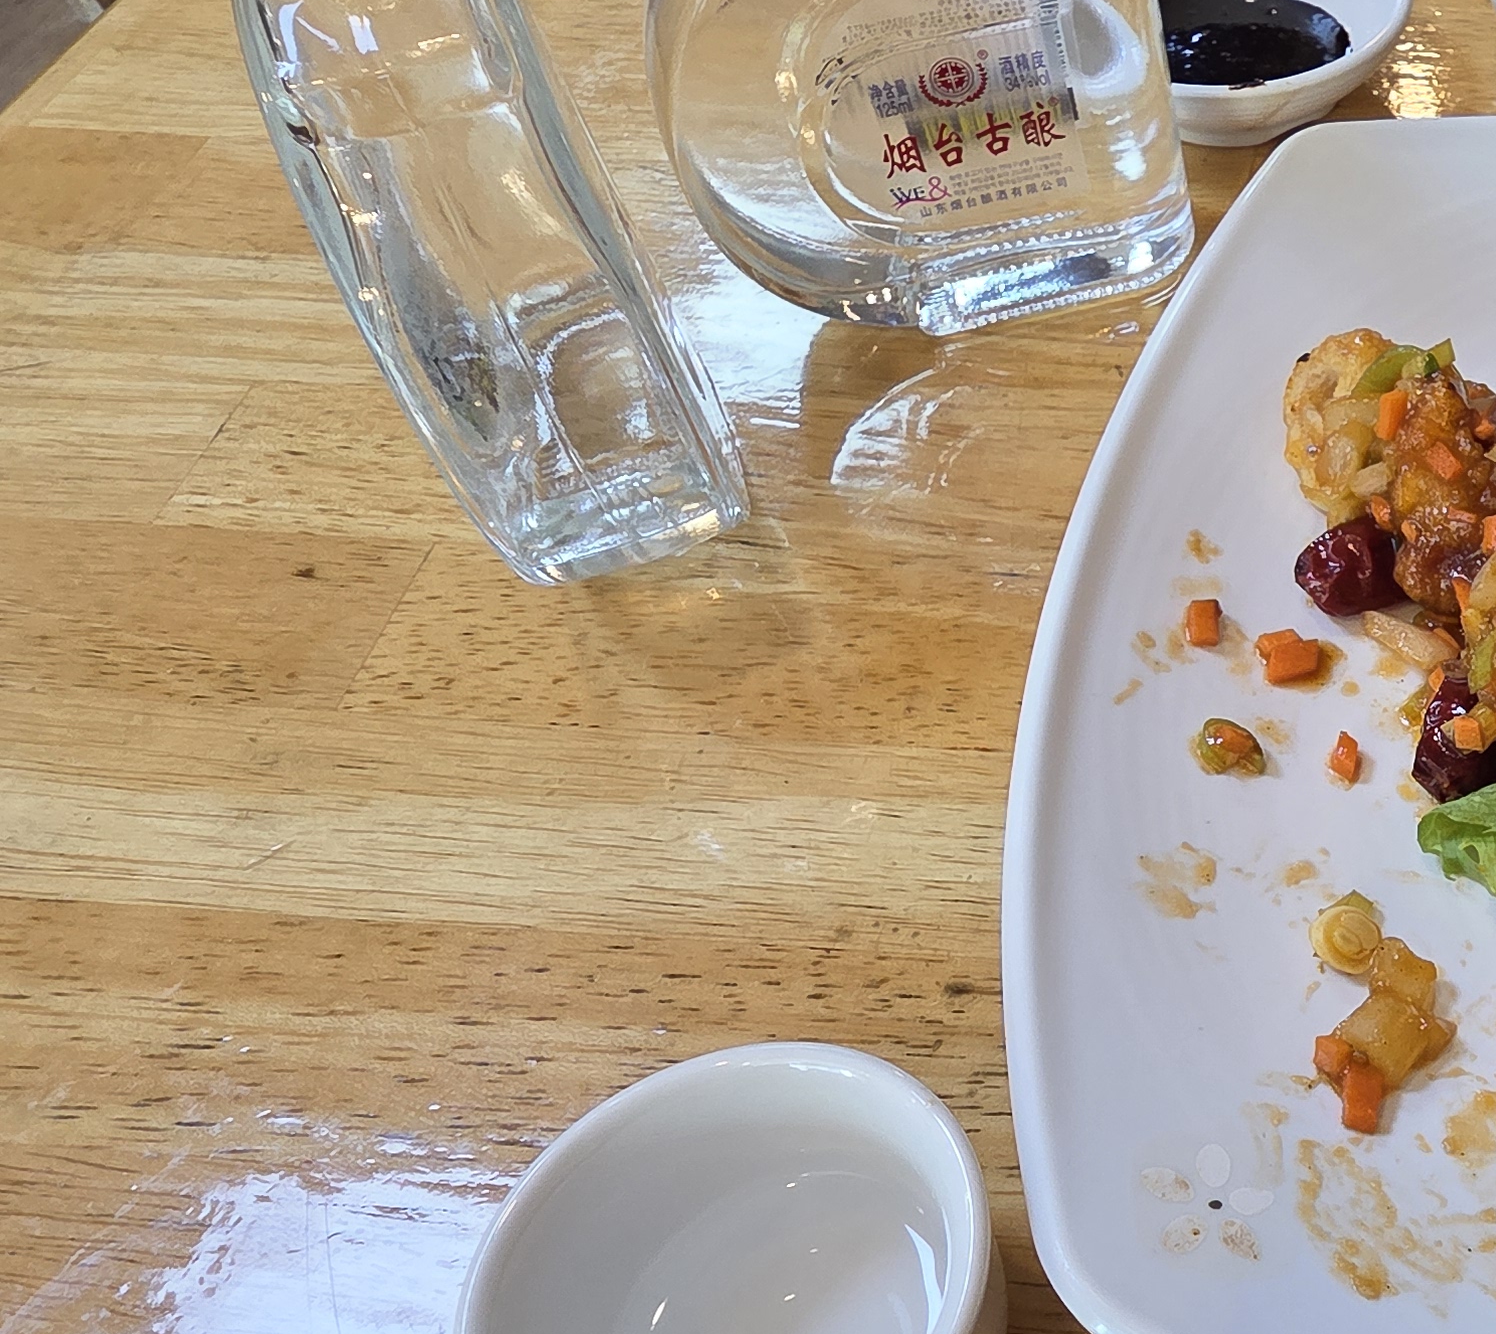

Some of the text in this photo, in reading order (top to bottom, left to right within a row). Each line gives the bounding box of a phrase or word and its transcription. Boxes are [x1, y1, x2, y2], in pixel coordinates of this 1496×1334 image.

[868, 78, 910, 102] 净含量
[875, 98, 914, 119] 125ml
[882, 102, 1066, 179] 烟台古酿
